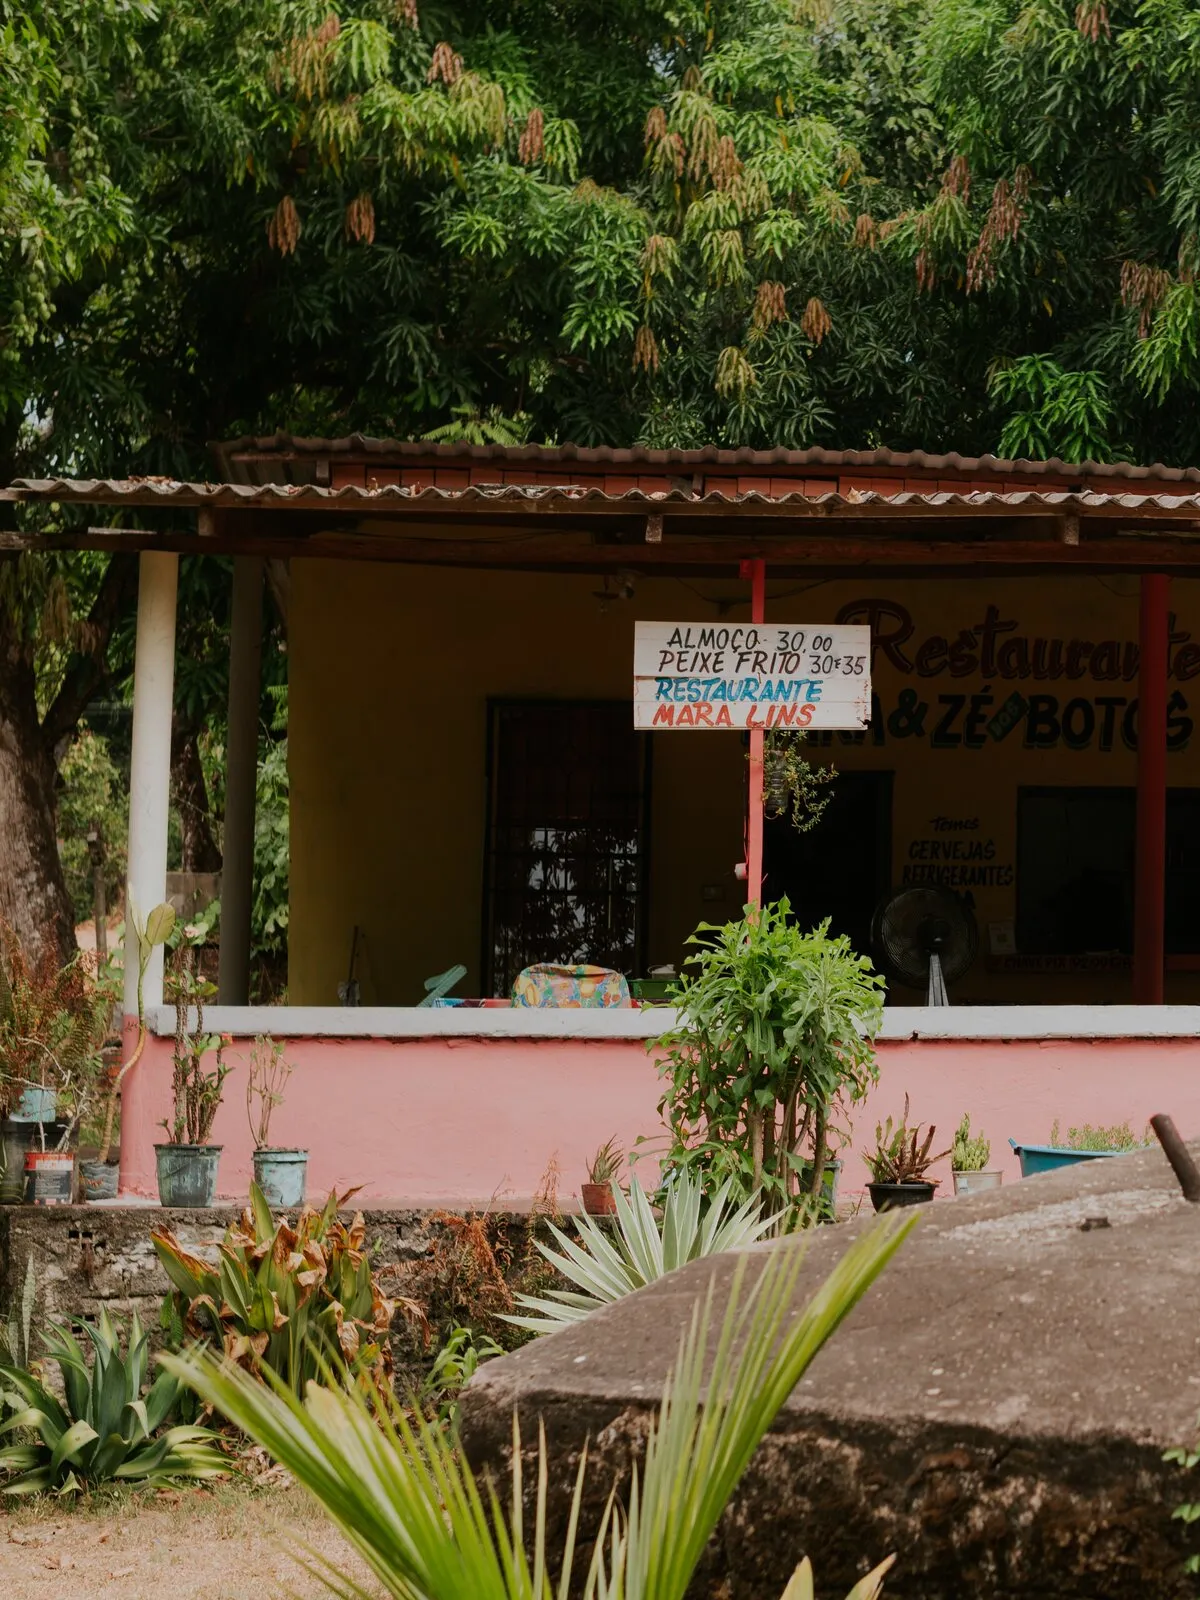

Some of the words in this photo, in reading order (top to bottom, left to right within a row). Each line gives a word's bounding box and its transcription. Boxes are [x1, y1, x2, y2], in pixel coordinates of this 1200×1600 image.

[667, 628, 760, 653] ALMOÇO
[776, 631, 832, 653] 30,00
[658, 650, 724, 673] PEIXE
[735, 651, 801, 674] FRITO
[655, 677, 824, 702] RESTAURANTE
[652, 702, 734, 727] MARA
[746, 702, 816, 727] LINS
[908, 839, 996, 861] CERVEJAS
